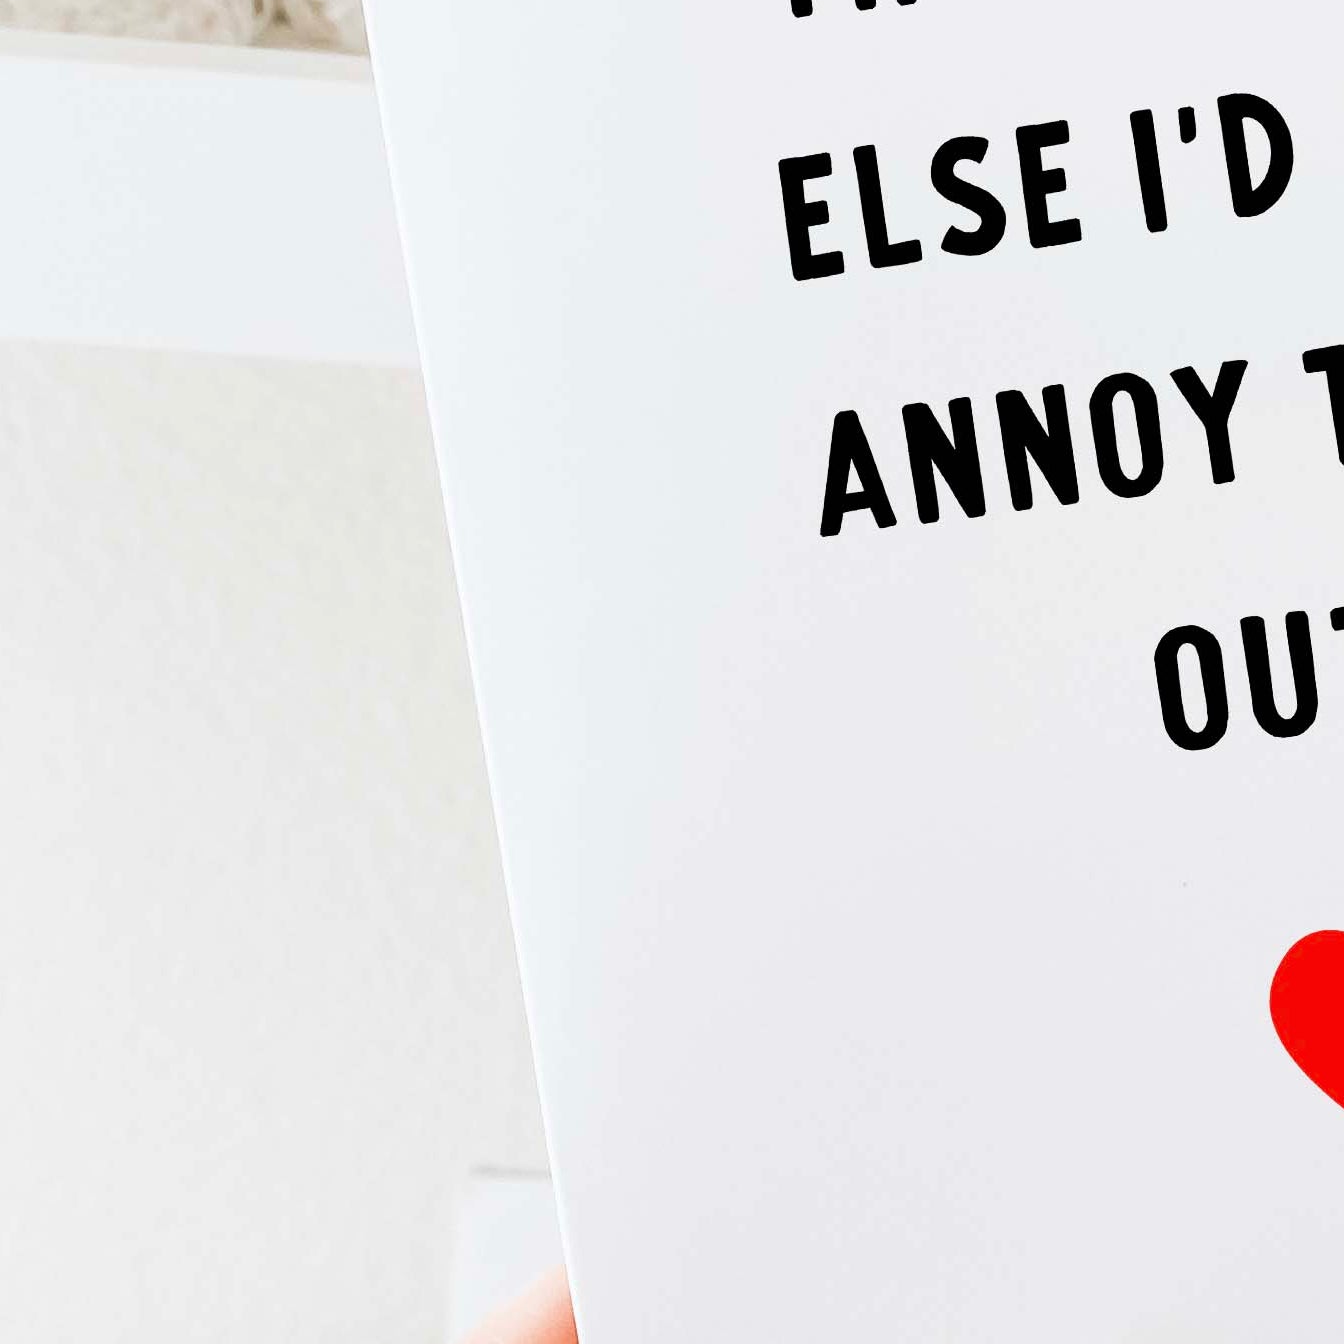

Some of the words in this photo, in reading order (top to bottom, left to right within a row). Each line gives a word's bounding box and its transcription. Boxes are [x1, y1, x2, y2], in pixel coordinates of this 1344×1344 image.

[778, 120, 1081, 281] ELSE
[1130, 93, 1293, 233] I'D
[820, 360, 1248, 537] ANNOY
